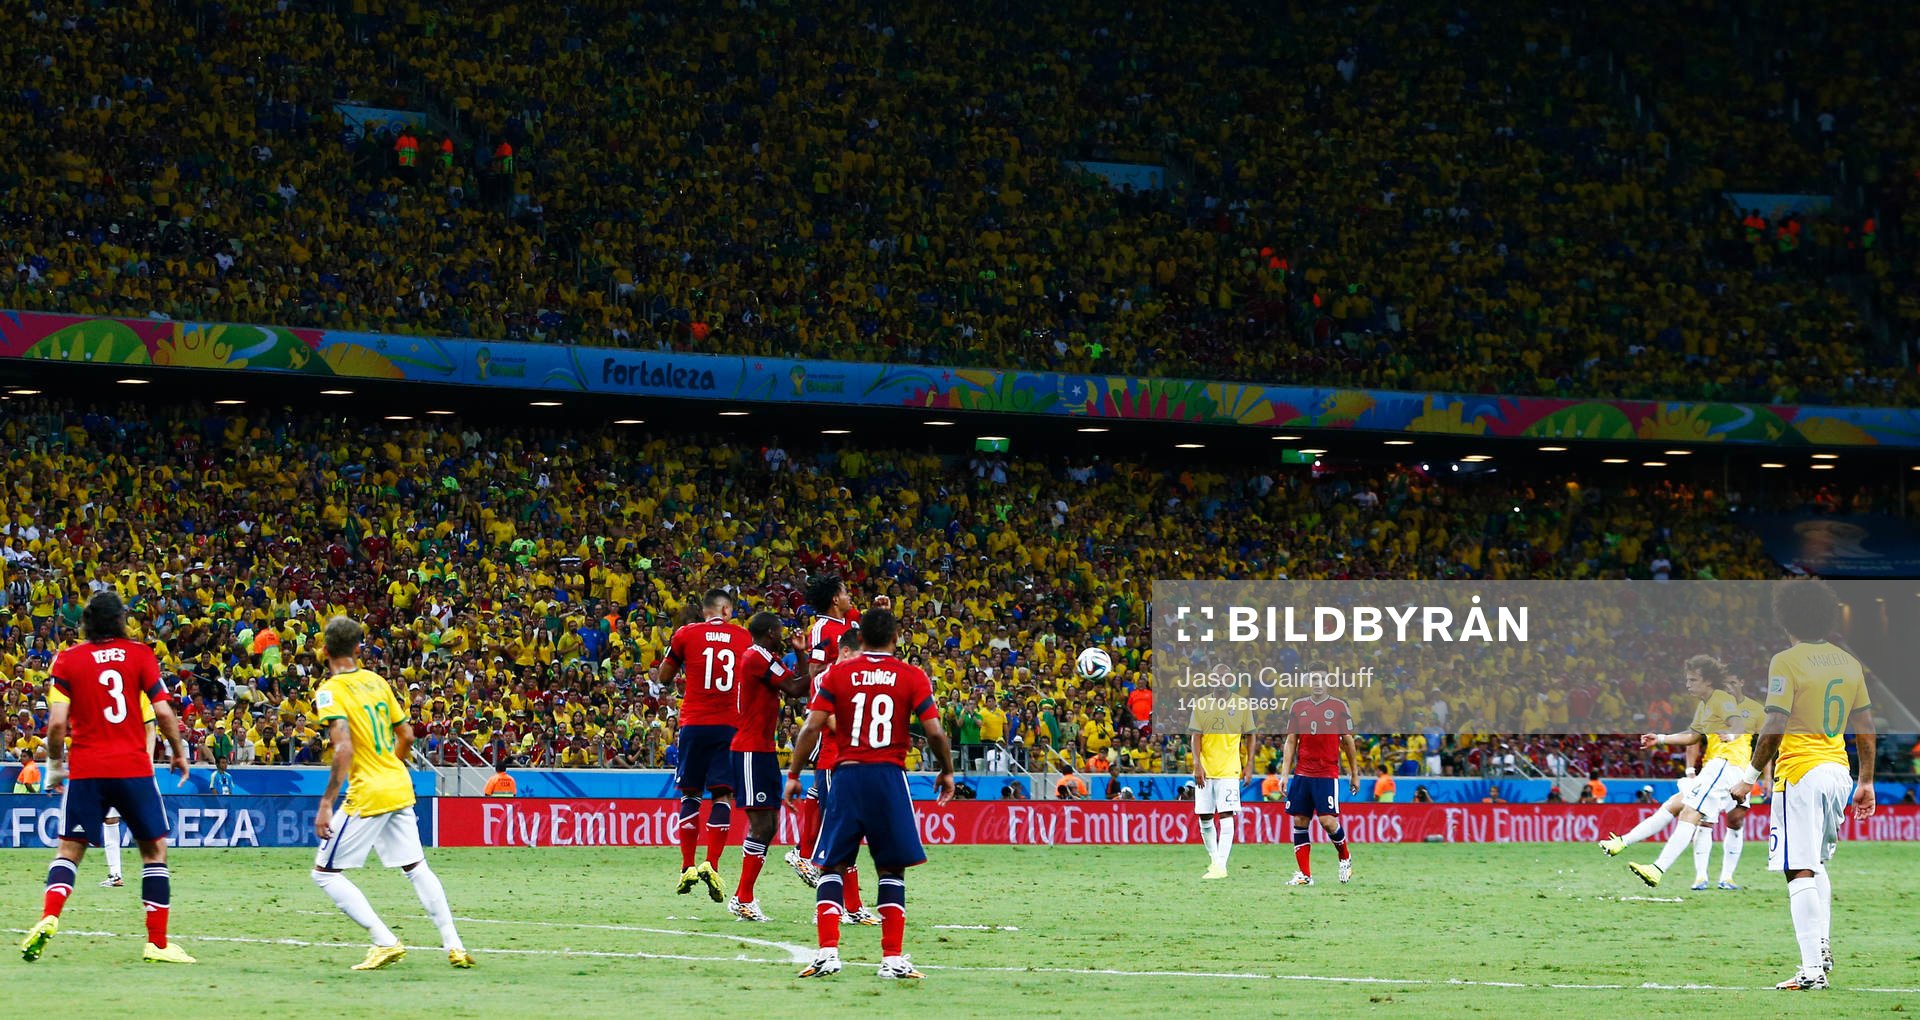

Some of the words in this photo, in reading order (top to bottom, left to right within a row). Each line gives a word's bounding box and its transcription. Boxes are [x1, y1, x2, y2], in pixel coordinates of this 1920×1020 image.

[602, 358, 715, 390] Fortaleza
[91, 647, 125, 664] YEPES
[702, 647, 735, 692] 13
[98, 668, 128, 724] 3
[1823, 678, 1845, 738] 6
[363, 701, 395, 756] 10
[850, 692, 894, 749] 18
[1211, 717, 1225, 731] 23
[1310, 720, 1318, 736] 9
[1225, 789, 1240, 802] 23
[1327, 795, 1335, 810] 9
[12, 807, 259, 847] FOEZA
[481, 803, 541, 848] Fly
[549, 801, 682, 845] Emirate
[1007, 805, 1057, 845] Fly
[1063, 803, 1189, 843] Emirates
[1236, 806, 1282, 844] Fly
[1445, 807, 1487, 844] Fly
[1492, 806, 1600, 843] Emirates
